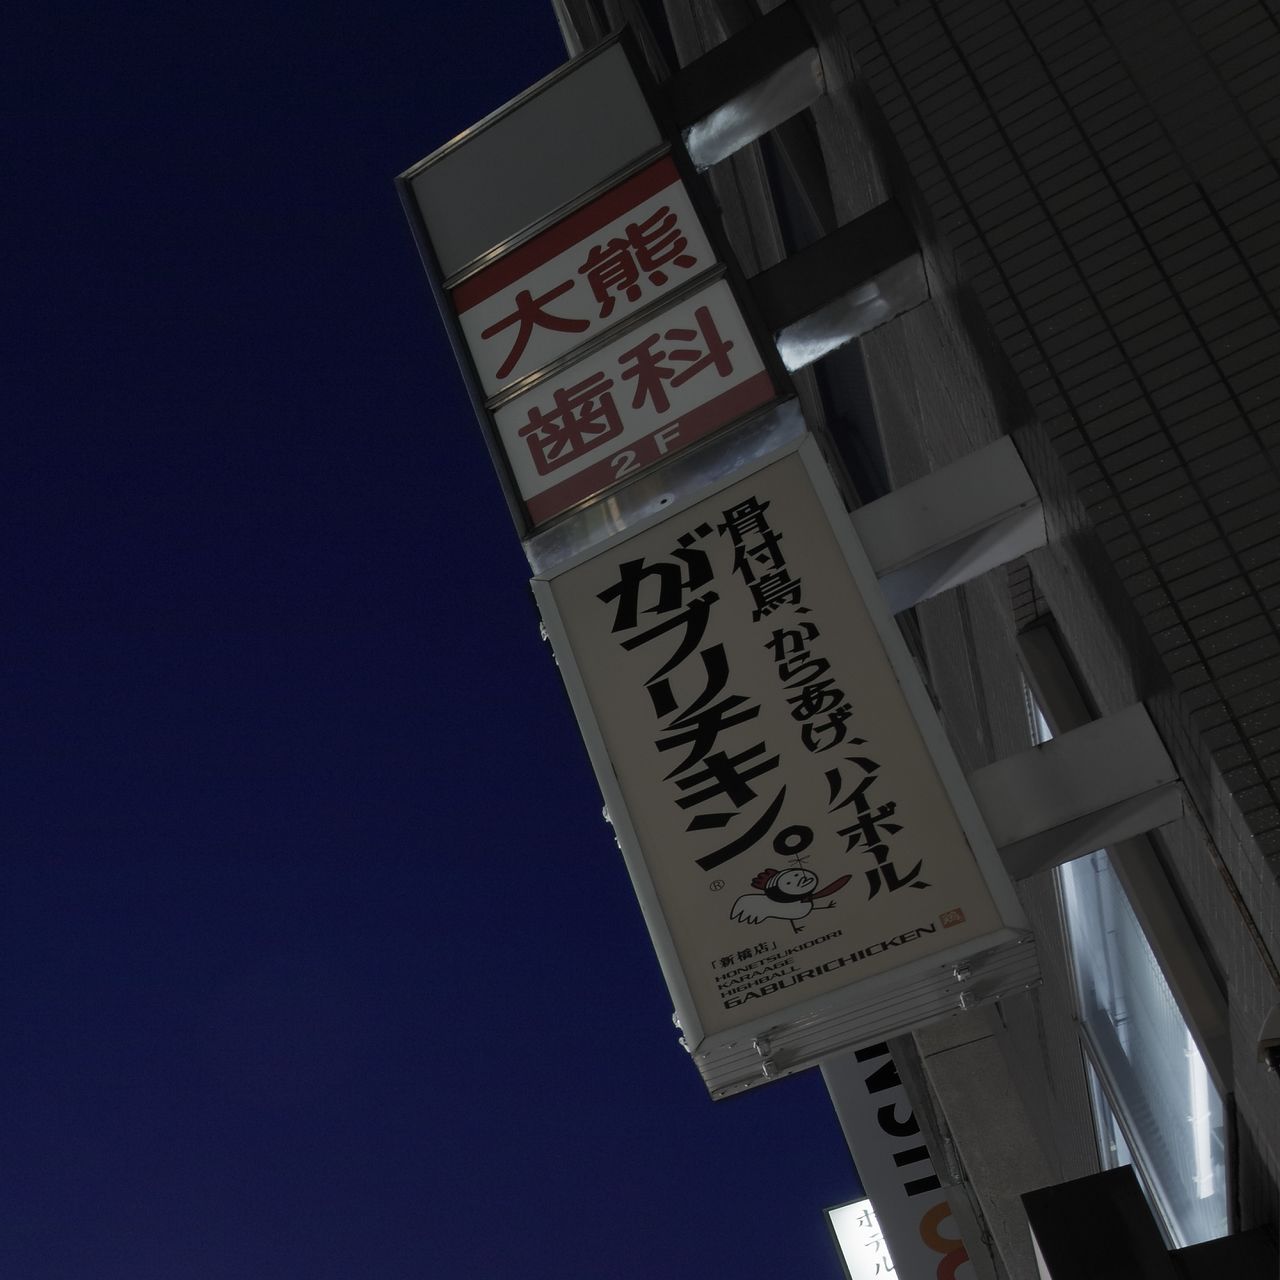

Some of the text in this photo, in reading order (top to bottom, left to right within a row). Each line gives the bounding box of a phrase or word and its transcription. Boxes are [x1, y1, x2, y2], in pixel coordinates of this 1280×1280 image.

[481, 206, 697, 379] 大熊
[518, 306, 734, 476] 歯科
[611, 422, 680, 479] 2F
[715, 930, 843, 983] HONETSUKIDORI
[717, 957, 795, 991] KARAAGE
[720, 966, 801, 998] HIGHBALL
[724, 923, 936, 1010] GABURICHICKEN
